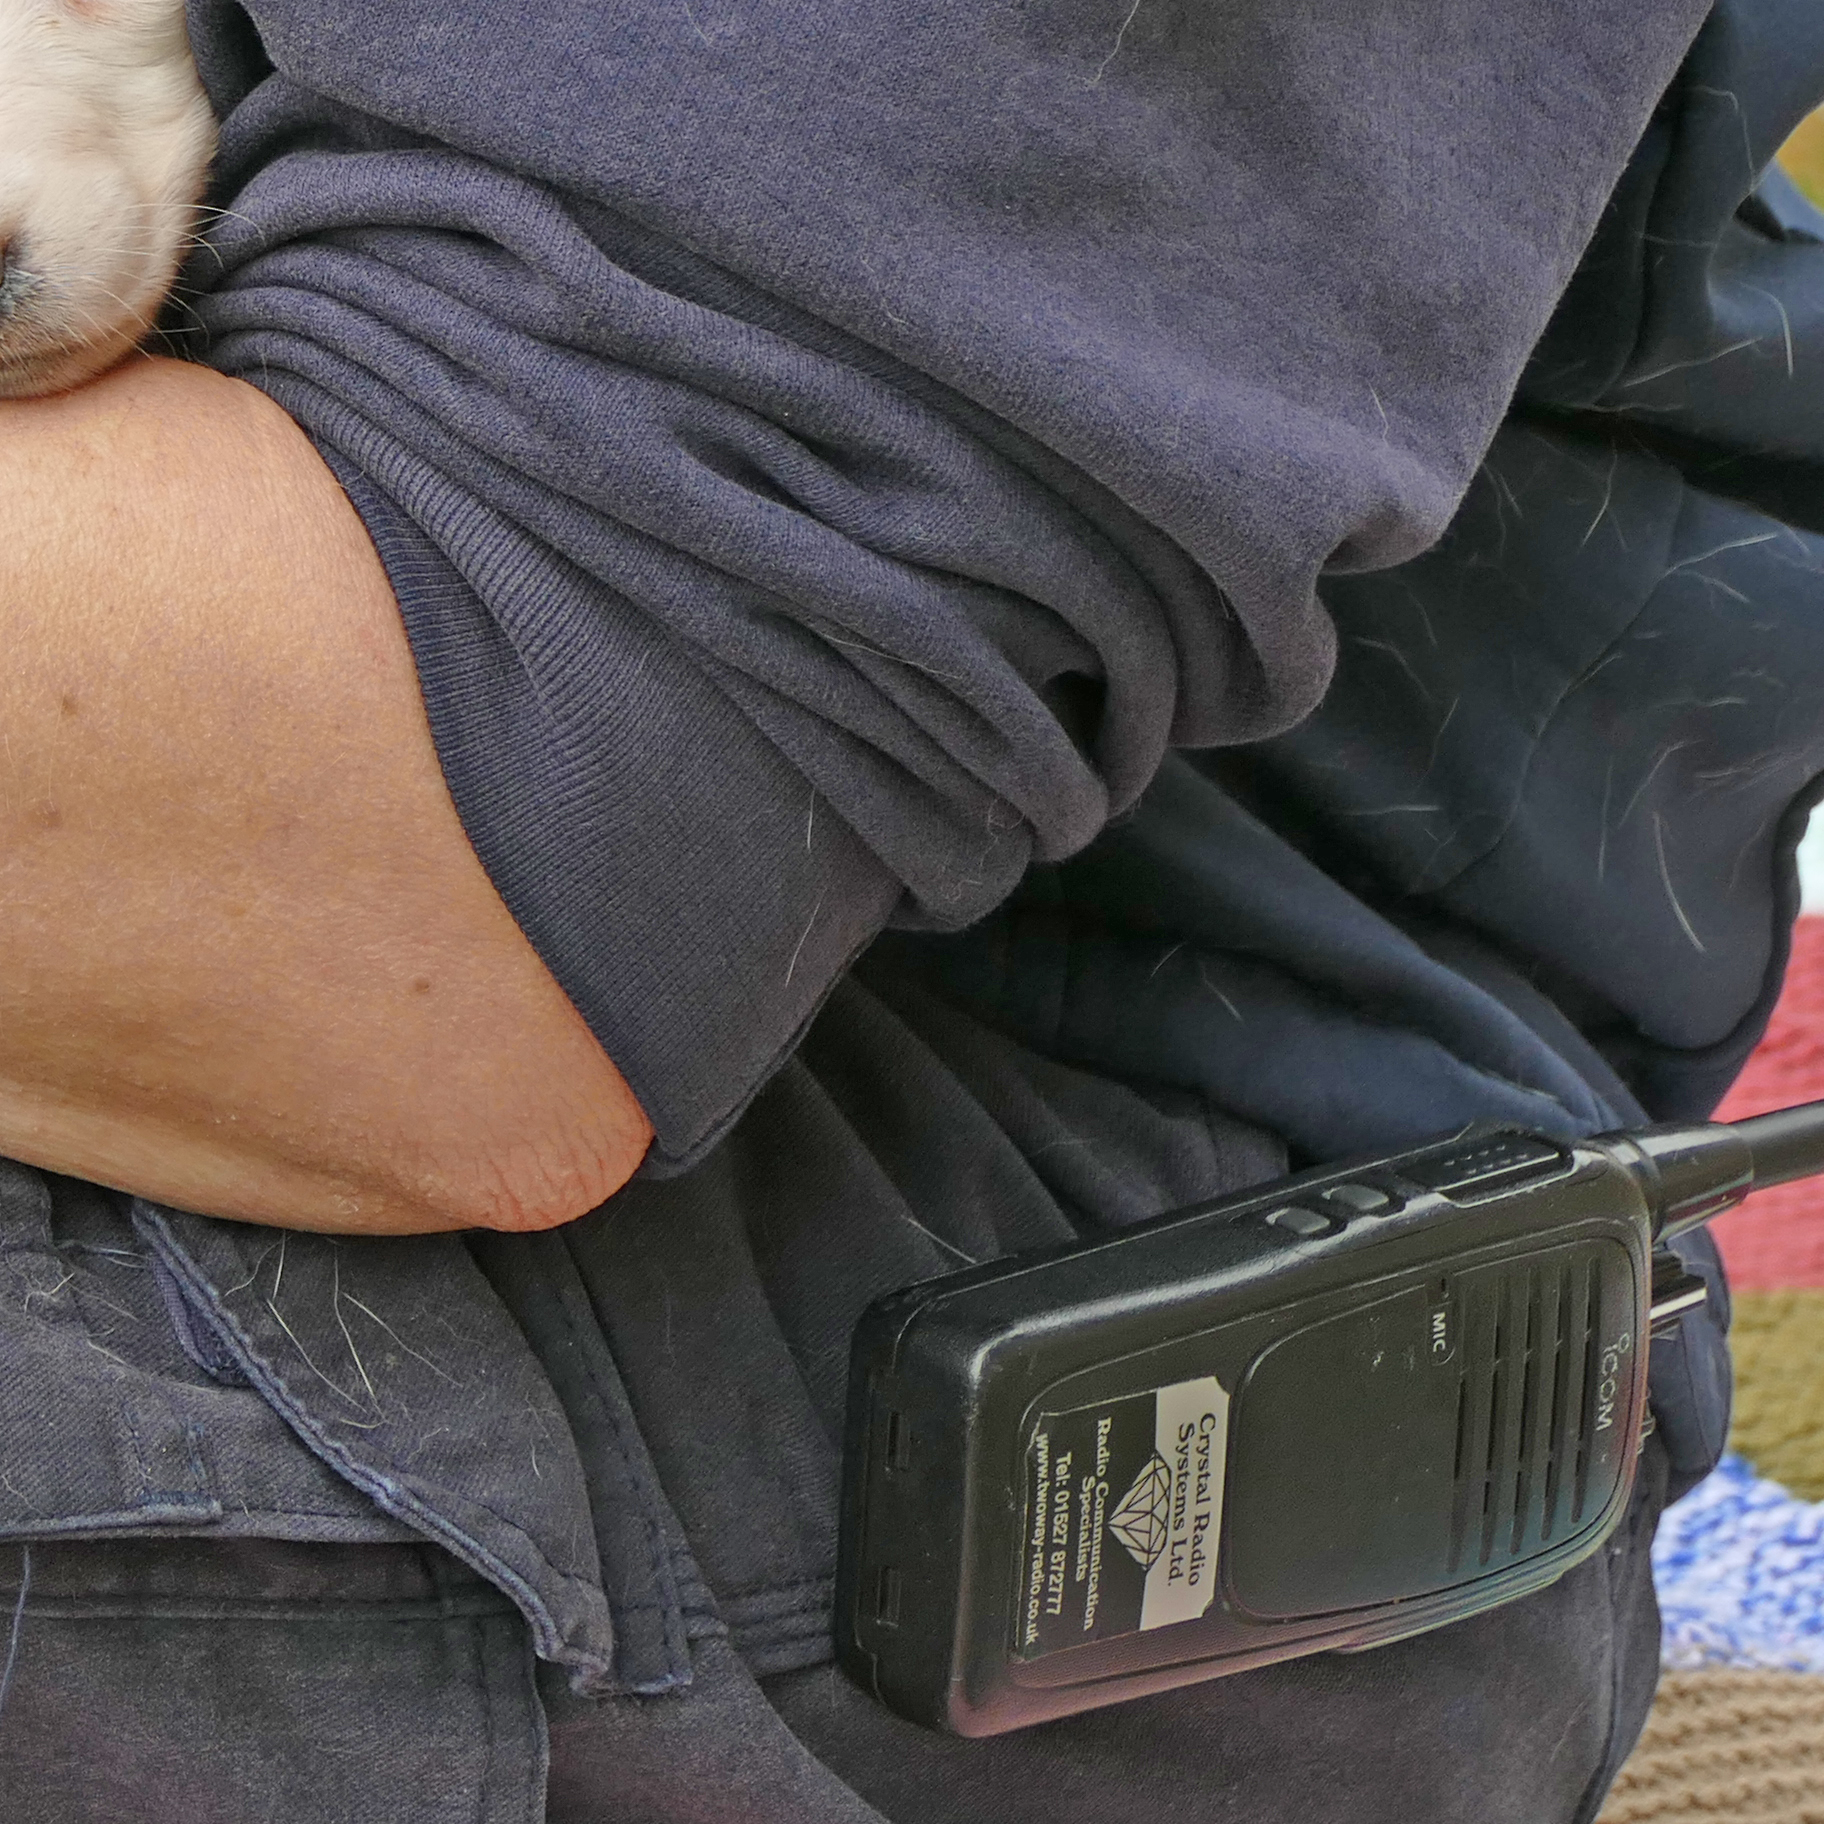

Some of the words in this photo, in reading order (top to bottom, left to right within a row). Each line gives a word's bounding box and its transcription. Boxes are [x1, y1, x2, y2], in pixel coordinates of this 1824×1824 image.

[1433, 1312, 1446, 1352] MIC
[1054, 1451, 1072, 1486] Tel:
[1095, 1417, 1112, 1477] Radio
[1172, 1422, 1195, 1531] Systems
[1193, 1412, 1216, 1505] Crystal
[1024, 1433, 1050, 1646] www.twoway-radio.co.uk
[1052, 1490, 1069, 1545] 01527
[1075, 1476, 1096, 1582] Specialists
[1188, 1513, 1210, 1586] Radio
[1046, 1551, 1065, 1615] 872777
[1082, 1481, 1109, 1631] Communication
[1167, 1538, 1188, 1587] Ltd.
